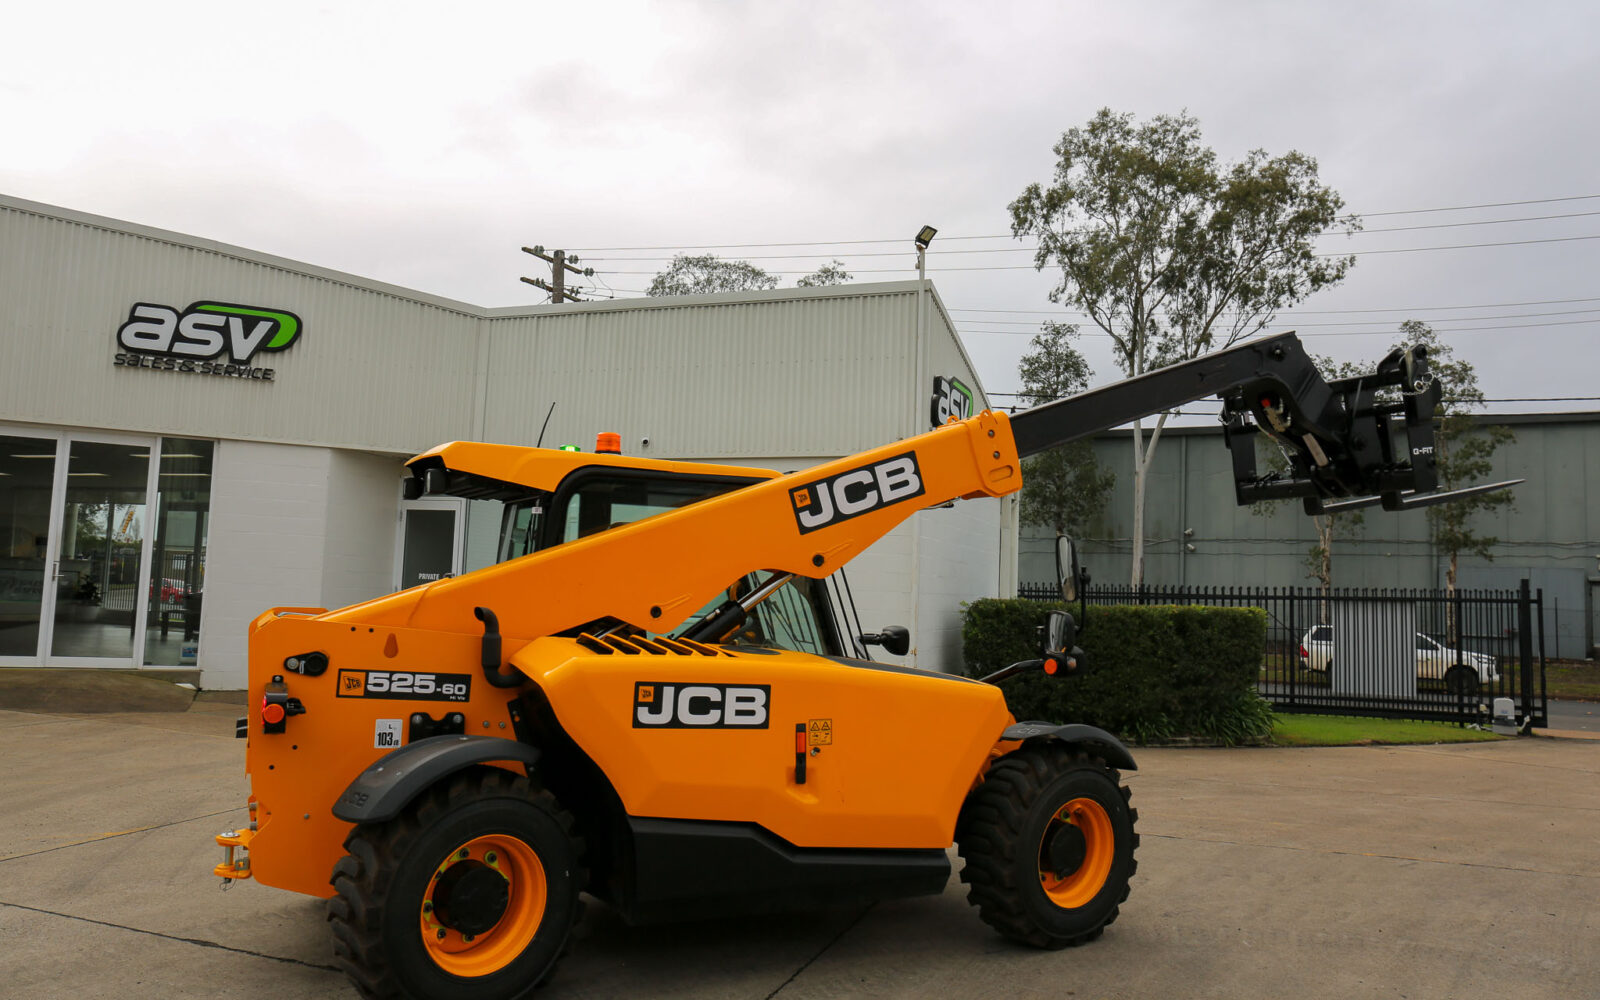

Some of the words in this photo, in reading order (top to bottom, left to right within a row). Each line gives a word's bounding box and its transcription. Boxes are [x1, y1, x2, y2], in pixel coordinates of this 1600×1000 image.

[178, 359, 196, 373] &
[200, 362, 275, 381] SERVICE
[798, 457, 921, 528] JCB
[637, 686, 767, 725] JCB
[377, 732, 393, 746] 103
